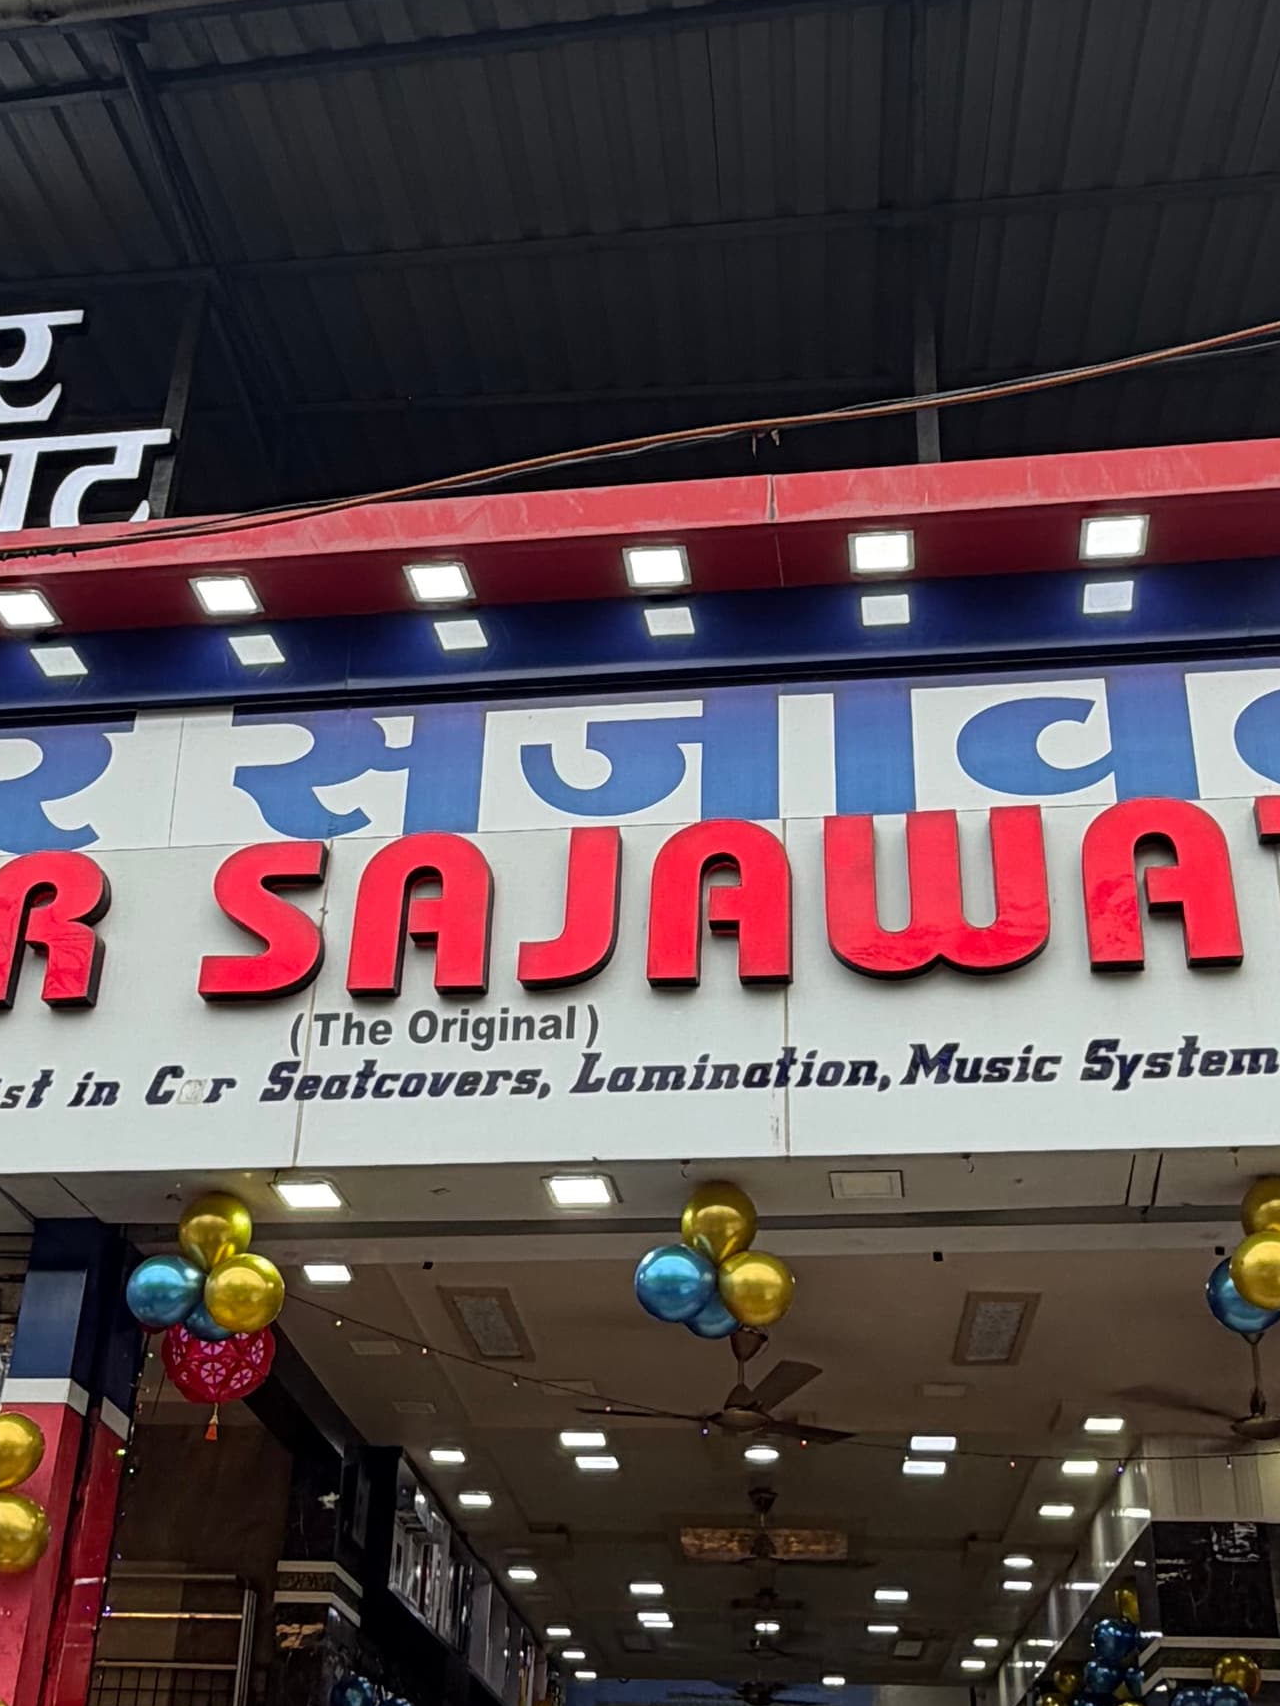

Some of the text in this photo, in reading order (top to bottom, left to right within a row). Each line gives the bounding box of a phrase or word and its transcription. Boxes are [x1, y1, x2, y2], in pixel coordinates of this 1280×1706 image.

[289, 1004, 601, 1055] (The Original)
[67, 1072, 120, 1107] in
[144, 1065, 236, 1105] Cr
[259, 1059, 550, 1102] Seatcovers,
[569, 1046, 891, 1096] Lamination,
[900, 1042, 1061, 1087] Music
[1079, 1035, 1280, 1090] System
